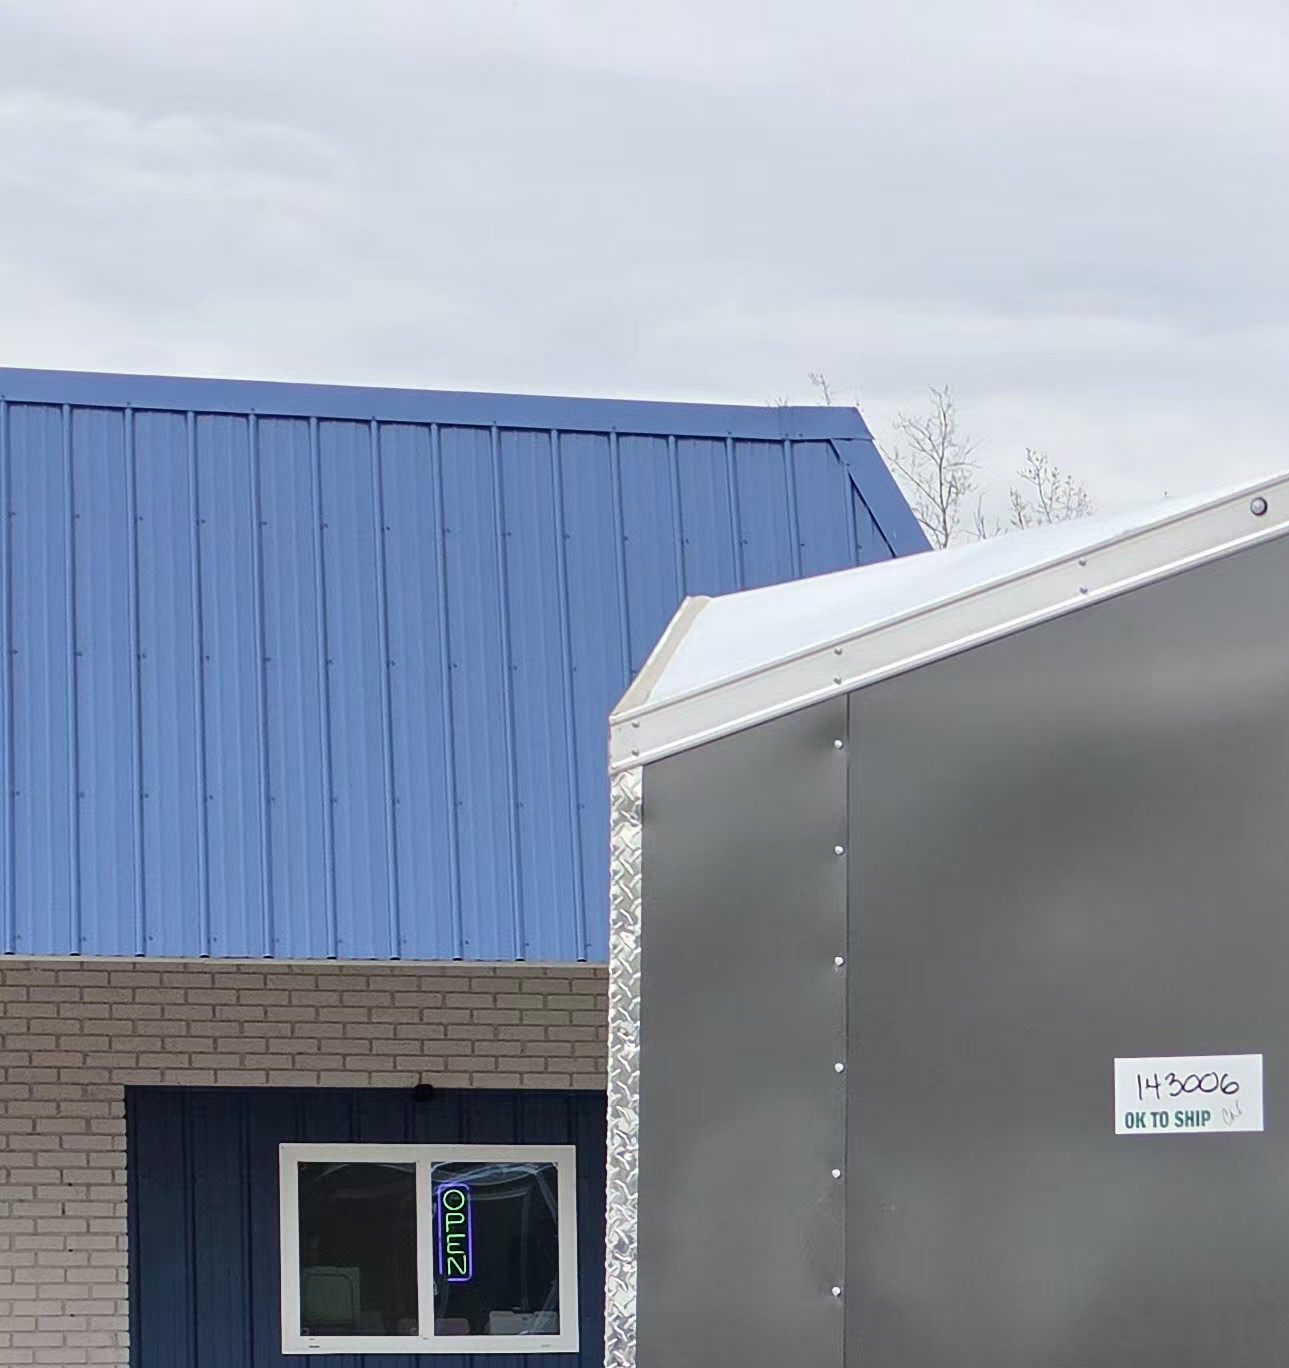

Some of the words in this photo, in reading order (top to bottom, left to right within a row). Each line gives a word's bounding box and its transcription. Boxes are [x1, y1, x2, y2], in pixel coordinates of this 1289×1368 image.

[1137, 1071, 1240, 1101] 143006
[1124, 1111, 1146, 1129] OK
[1150, 1110, 1169, 1128] TO
[1174, 1110, 1211, 1128] SHIP
[443, 1189, 467, 1276] OPEN
